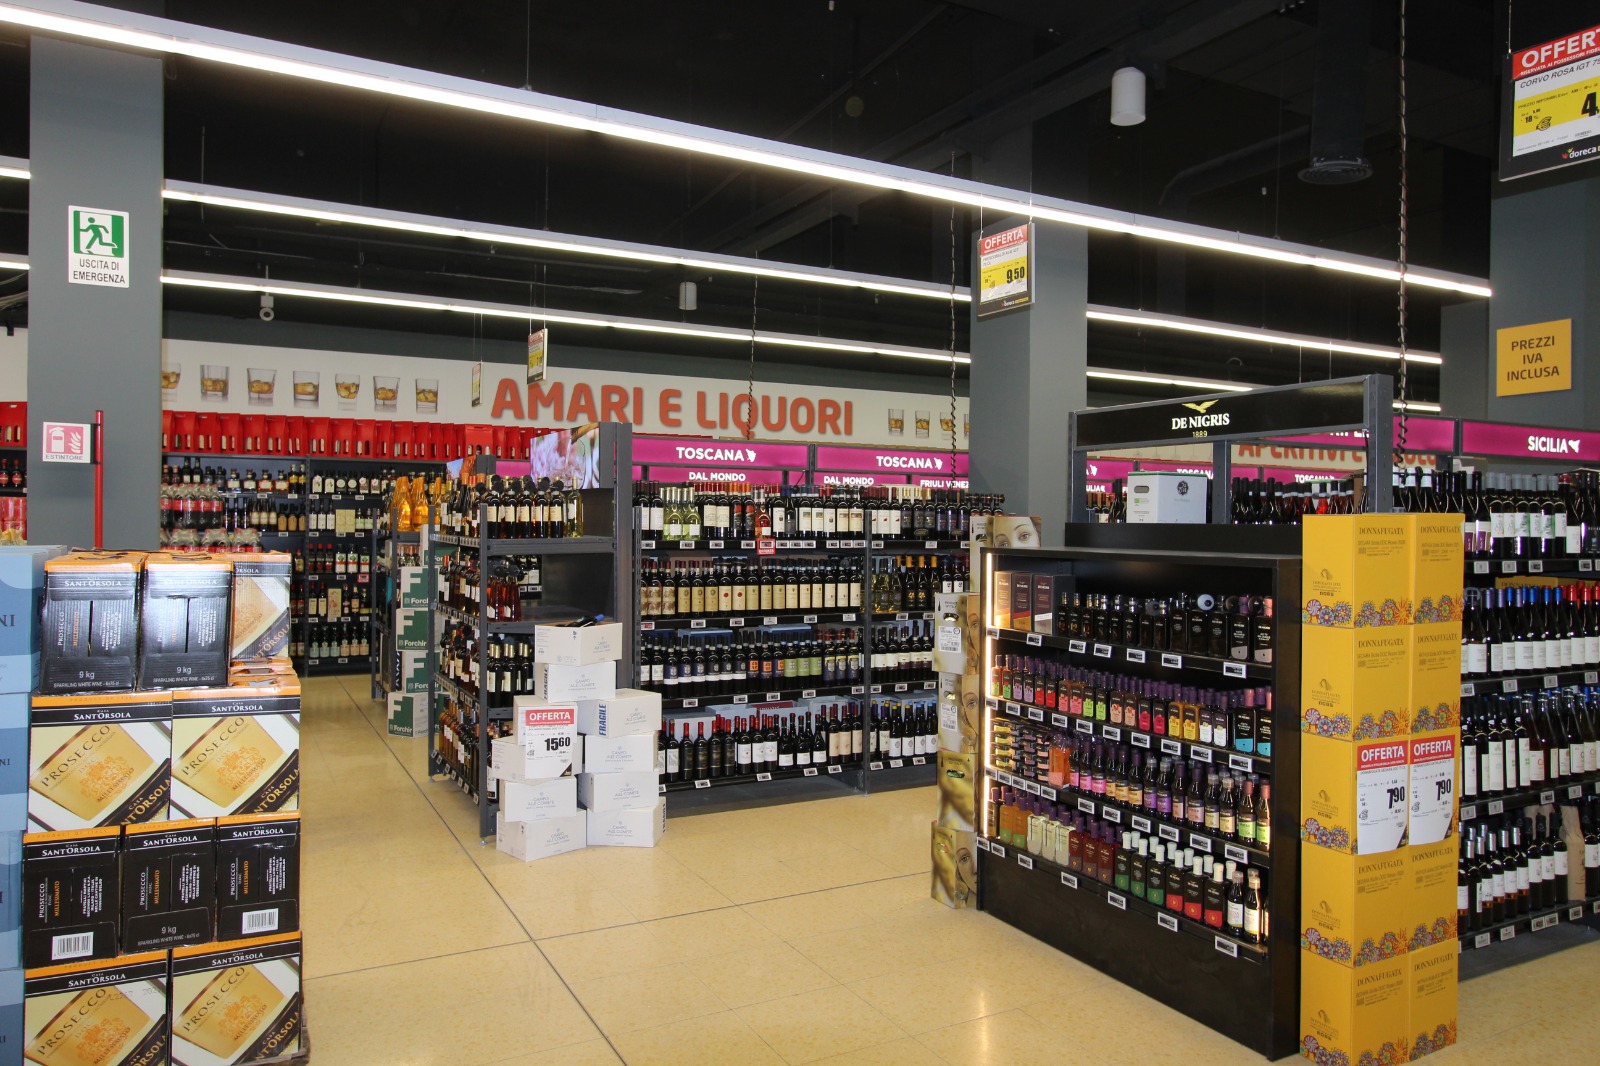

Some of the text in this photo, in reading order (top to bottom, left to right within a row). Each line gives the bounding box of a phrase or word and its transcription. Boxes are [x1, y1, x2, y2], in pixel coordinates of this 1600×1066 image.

[1520, 74, 1550, 88] CORVO
[1550, 66, 1574, 79] ROSA
[1576, 60, 1590, 71] IGT
[1569, 146, 1597, 158] doreca
[984, 228, 1024, 249] OFFERTA
[79, 258, 119, 271] USCITA DI
[73, 271, 125, 284] EMERGENZA
[1511, 335, 1555, 351] PREZZI
[1522, 352, 1543, 364] IVA
[1507, 366, 1560, 381] INCLUSA
[491, 378, 853, 438] AMARI E LIQUORI
[1171, 413, 1230, 430] DE NIGRIS
[1192, 430, 1208, 438] 1889
[1527, 435, 1568, 453] SICILIA
[676, 447, 744, 461] TOSCANA
[876, 456, 933, 469] TOSCANA
[688, 472, 746, 482] DAL MONDO
[824, 476, 874, 486] DAL MONDO
[920, 480, 944, 488] FRIULI
[1359, 527, 1404, 535] DONNAFUGATA
[1420, 526, 1460, 534] DONNAFUGATA
[1358, 639, 1404, 648] DONNAFUGATA
[1417, 633, 1458, 644] DONNAFUGATA
[85, 671, 95, 679] kg
[415, 682, 442, 690] Forcir
[529, 712, 571, 721] OFFERTA
[393, 724, 412, 733] Forchir
[182, 717, 245, 776] PROSECCO
[1413, 740, 1452, 756] OFFERTA
[41, 725, 111, 787] PROSECCO
[1361, 745, 1404, 762] OFFERTA
[1412, 847, 1454, 862] DONNAFUGATA
[1358, 858, 1404, 875] DONNAFUGATA
[167, 926, 176, 934] kg
[138, 938, 160, 946] SPARKLING
[1414, 953, 1454, 972] DONNAFUGATA
[1357, 968, 1402, 986] DONNAFUGATA
[183, 967, 245, 1032] PROSECCO
[37, 988, 107, 1056] PROSECCO
